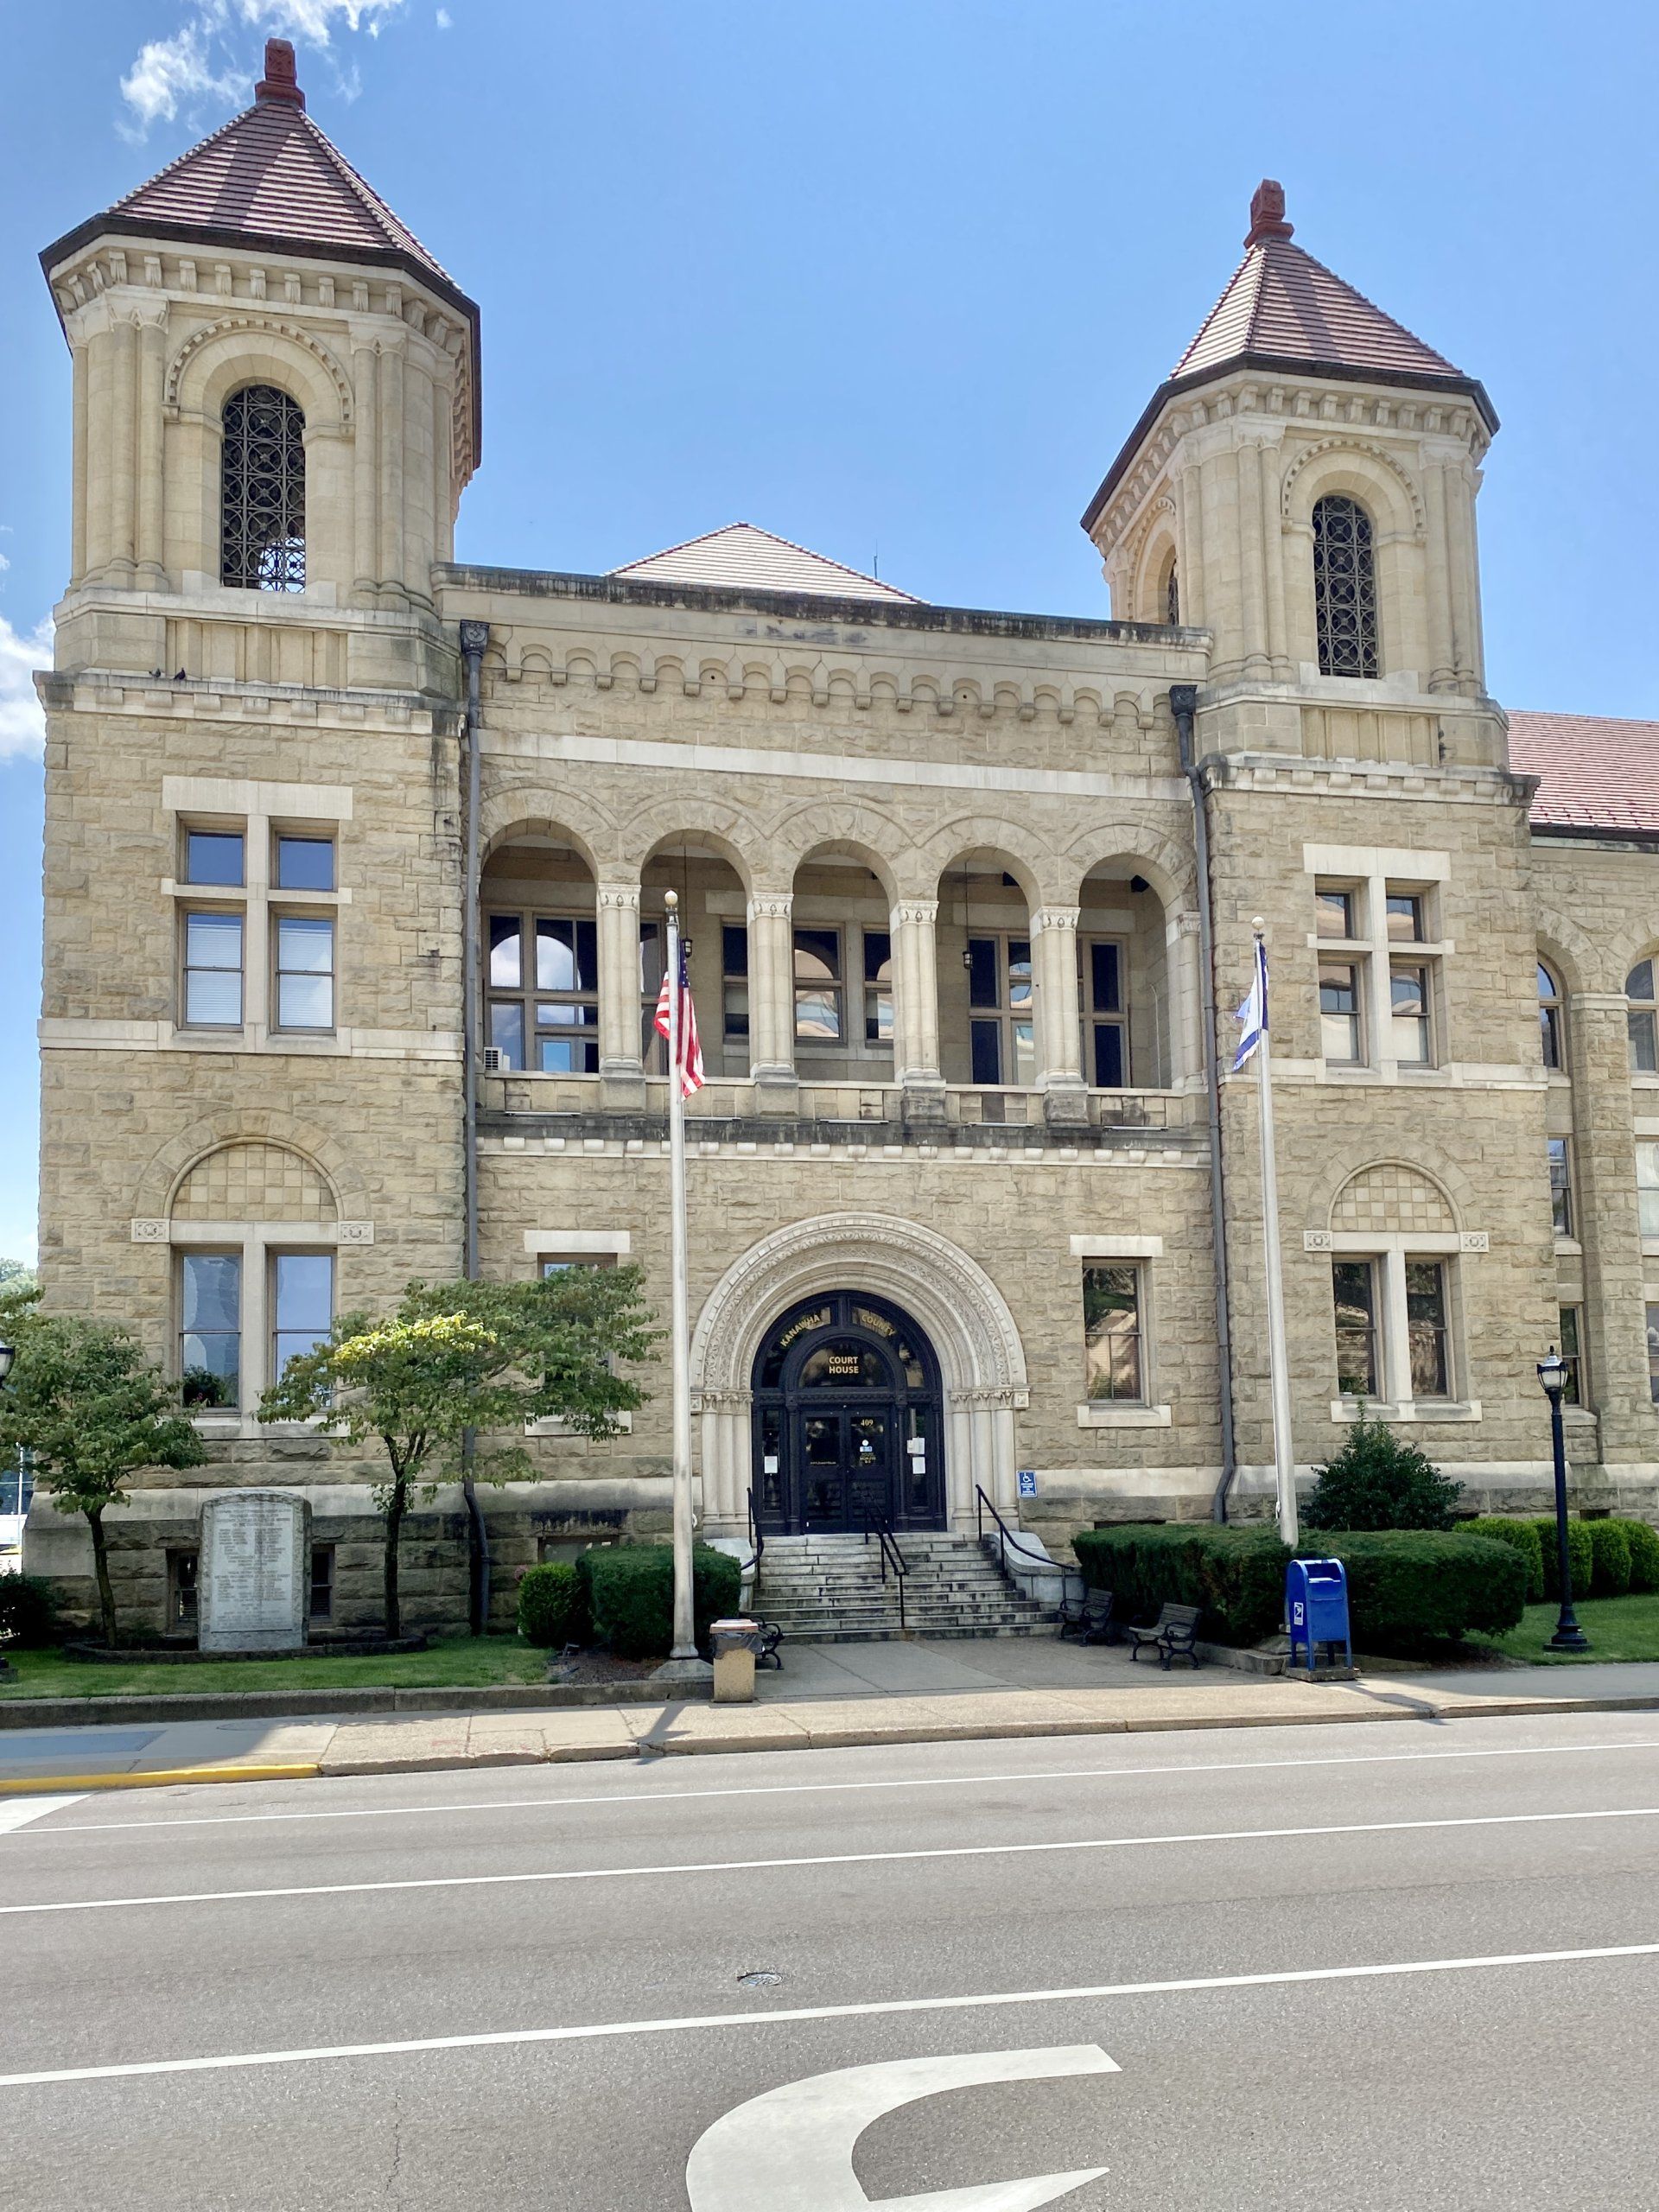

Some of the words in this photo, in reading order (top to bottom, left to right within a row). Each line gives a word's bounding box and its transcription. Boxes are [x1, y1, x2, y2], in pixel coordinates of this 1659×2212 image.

[779, 1314, 820, 1347] KANAWHA
[861, 1314, 896, 1337] COUNTY
[829, 1356, 859, 1364] COURT
